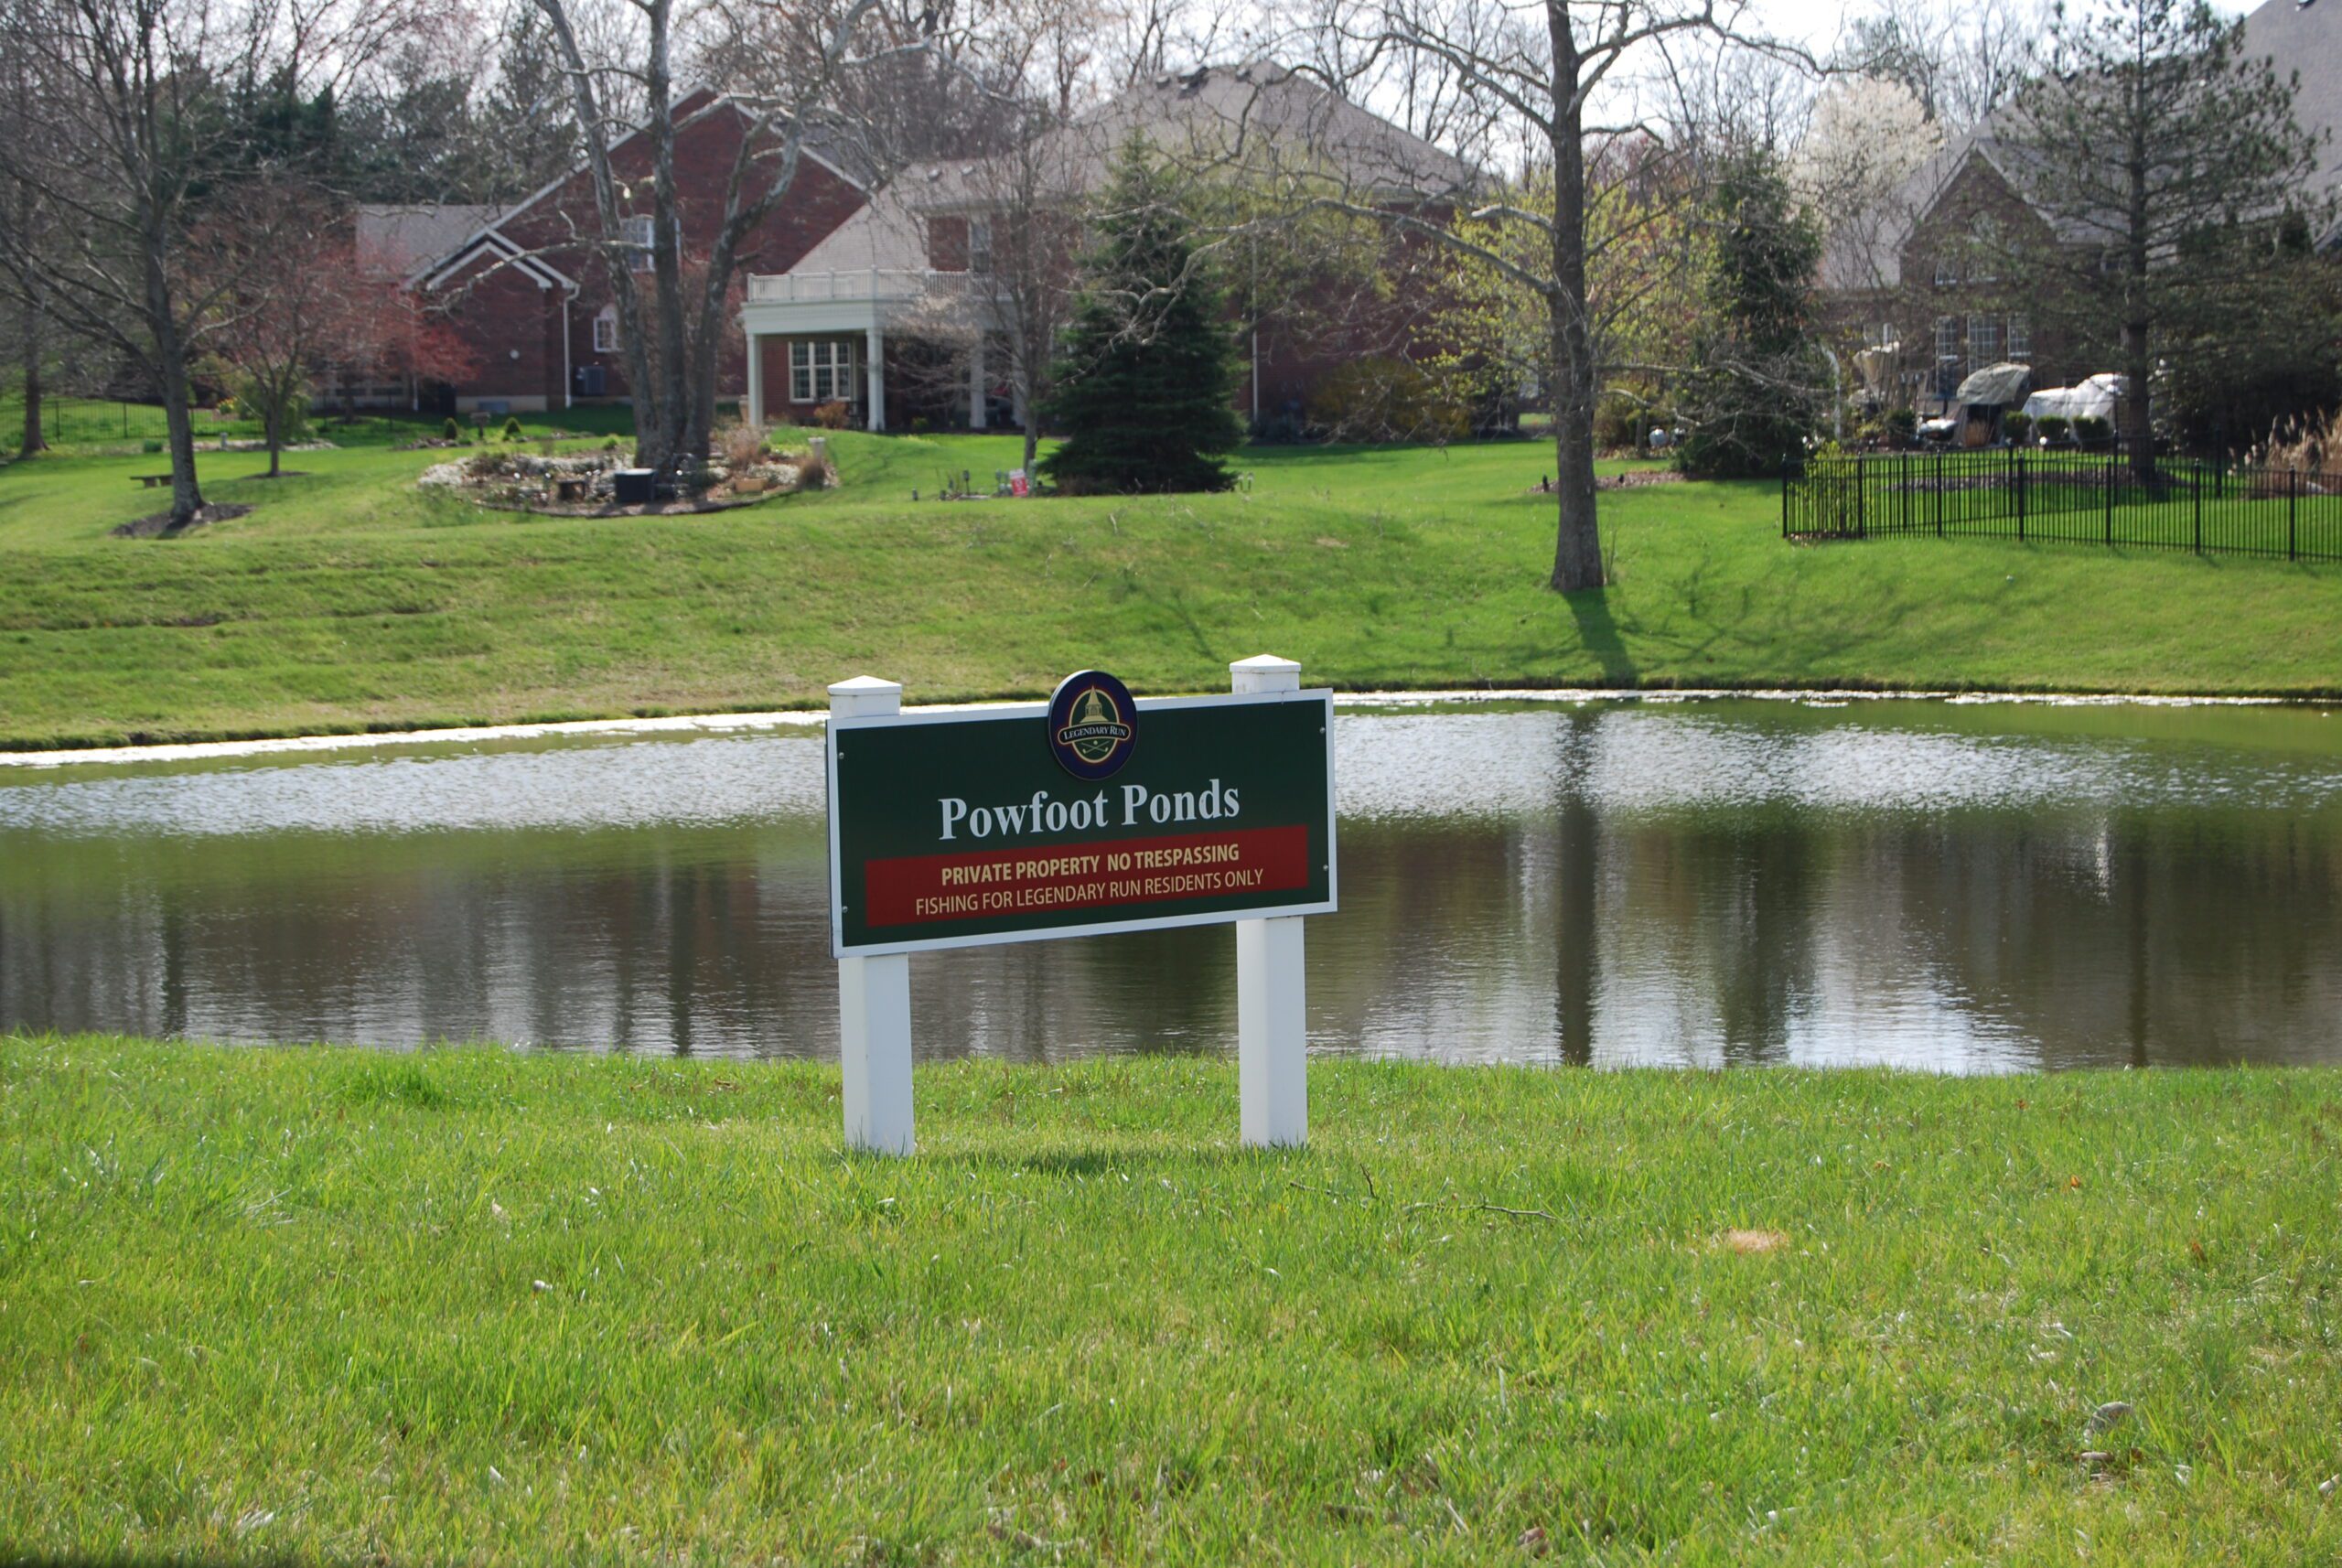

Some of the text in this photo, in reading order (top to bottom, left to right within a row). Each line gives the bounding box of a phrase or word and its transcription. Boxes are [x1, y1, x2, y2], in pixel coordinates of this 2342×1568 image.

[1063, 725, 1126, 740] LEGENDARY RUN
[938, 779, 1240, 840] Powfoot Ponds
[941, 843, 1240, 886] PRIVATE PROPERTY NO TRESPASSING
[916, 868, 1263, 915] FISHING FOR LEGENDARY RUN RESIDENTS ONLY
